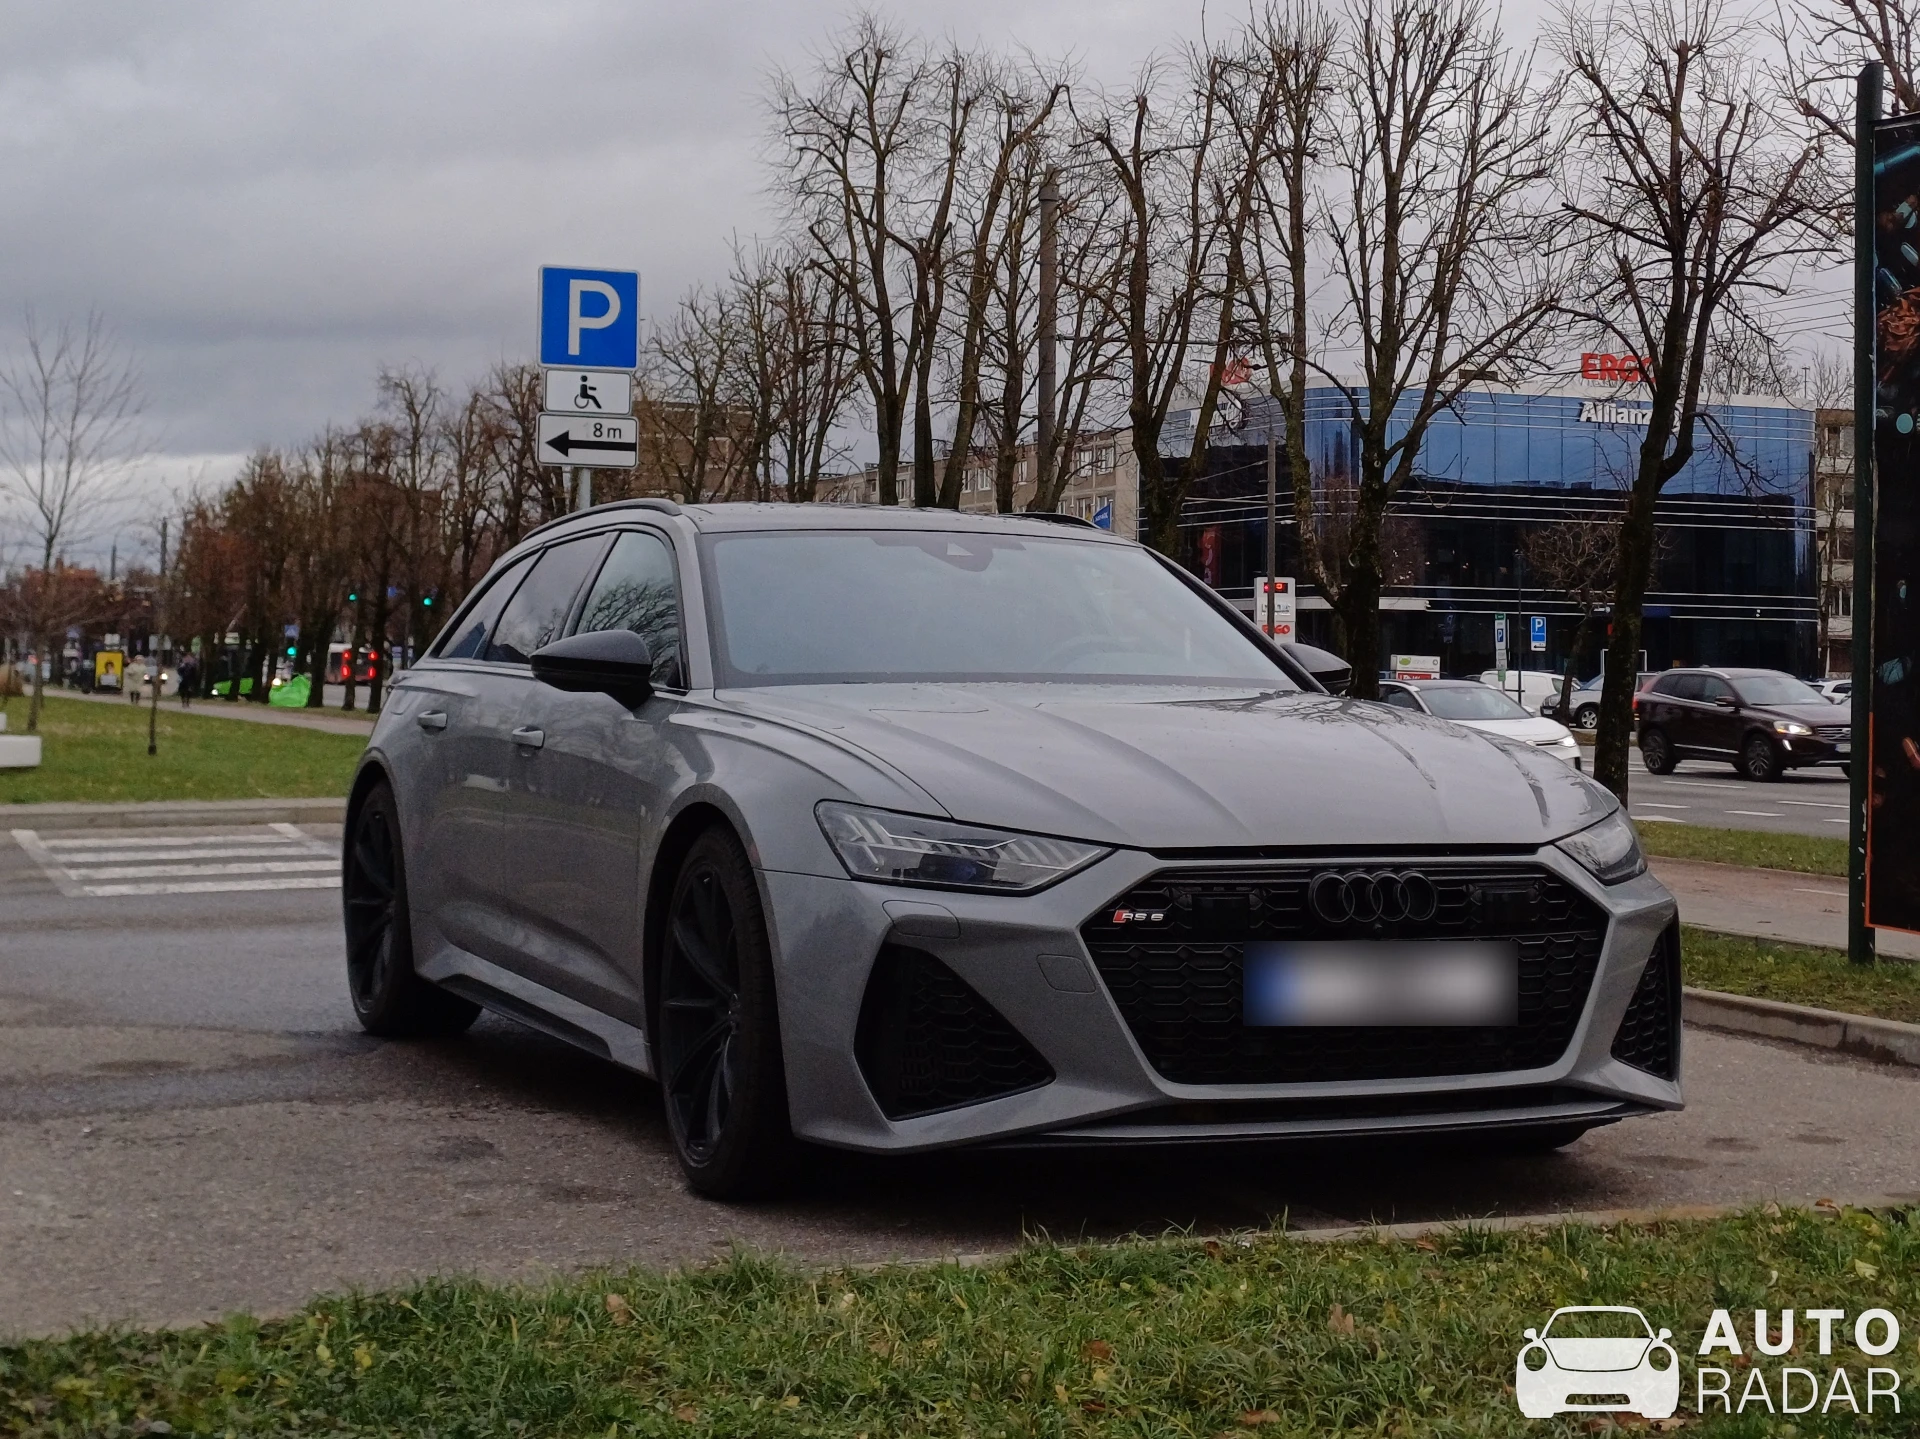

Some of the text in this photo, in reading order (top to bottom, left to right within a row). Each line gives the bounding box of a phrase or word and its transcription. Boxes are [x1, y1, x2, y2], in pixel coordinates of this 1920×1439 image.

[568, 278, 621, 356] P
[1580, 401, 1653, 424] Allianz
[593, 423, 622, 440] 8 m
[1535, 618, 1543, 632] P
